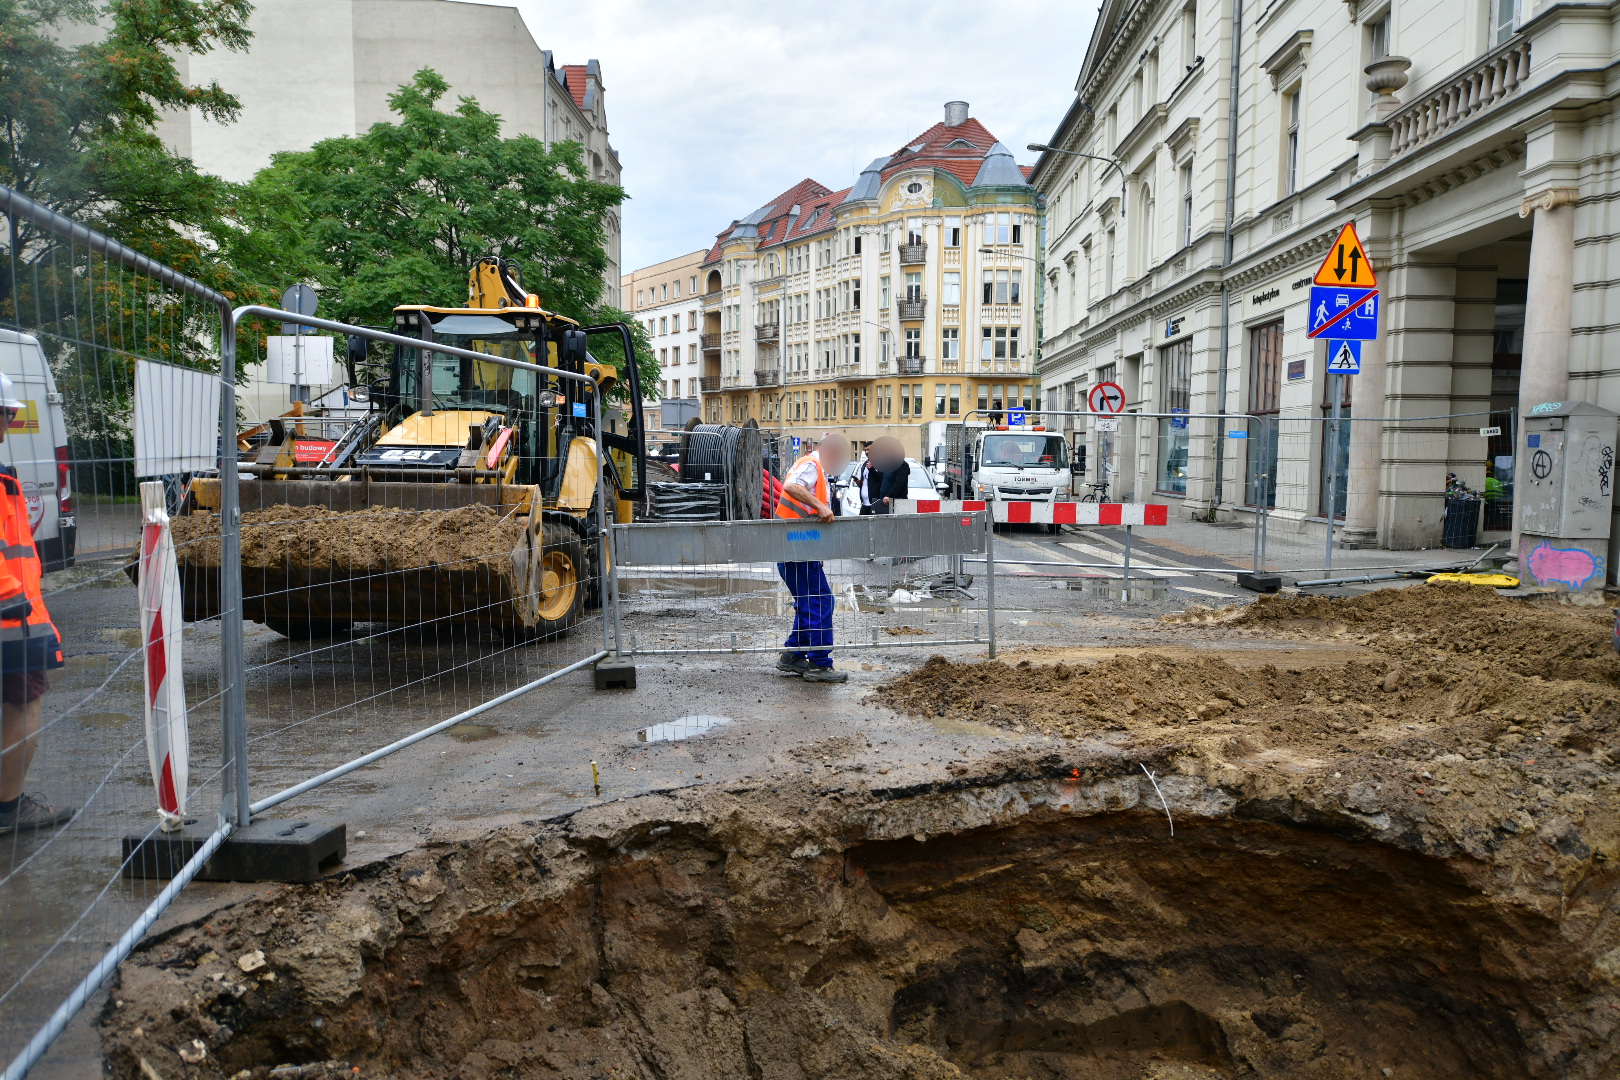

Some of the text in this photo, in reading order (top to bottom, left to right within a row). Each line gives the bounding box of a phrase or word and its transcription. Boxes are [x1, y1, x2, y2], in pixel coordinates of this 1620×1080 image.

[1291, 276, 1313, 291] centrum
[300, 444, 327, 452] budowy
[379, 449, 442, 461] CAT
